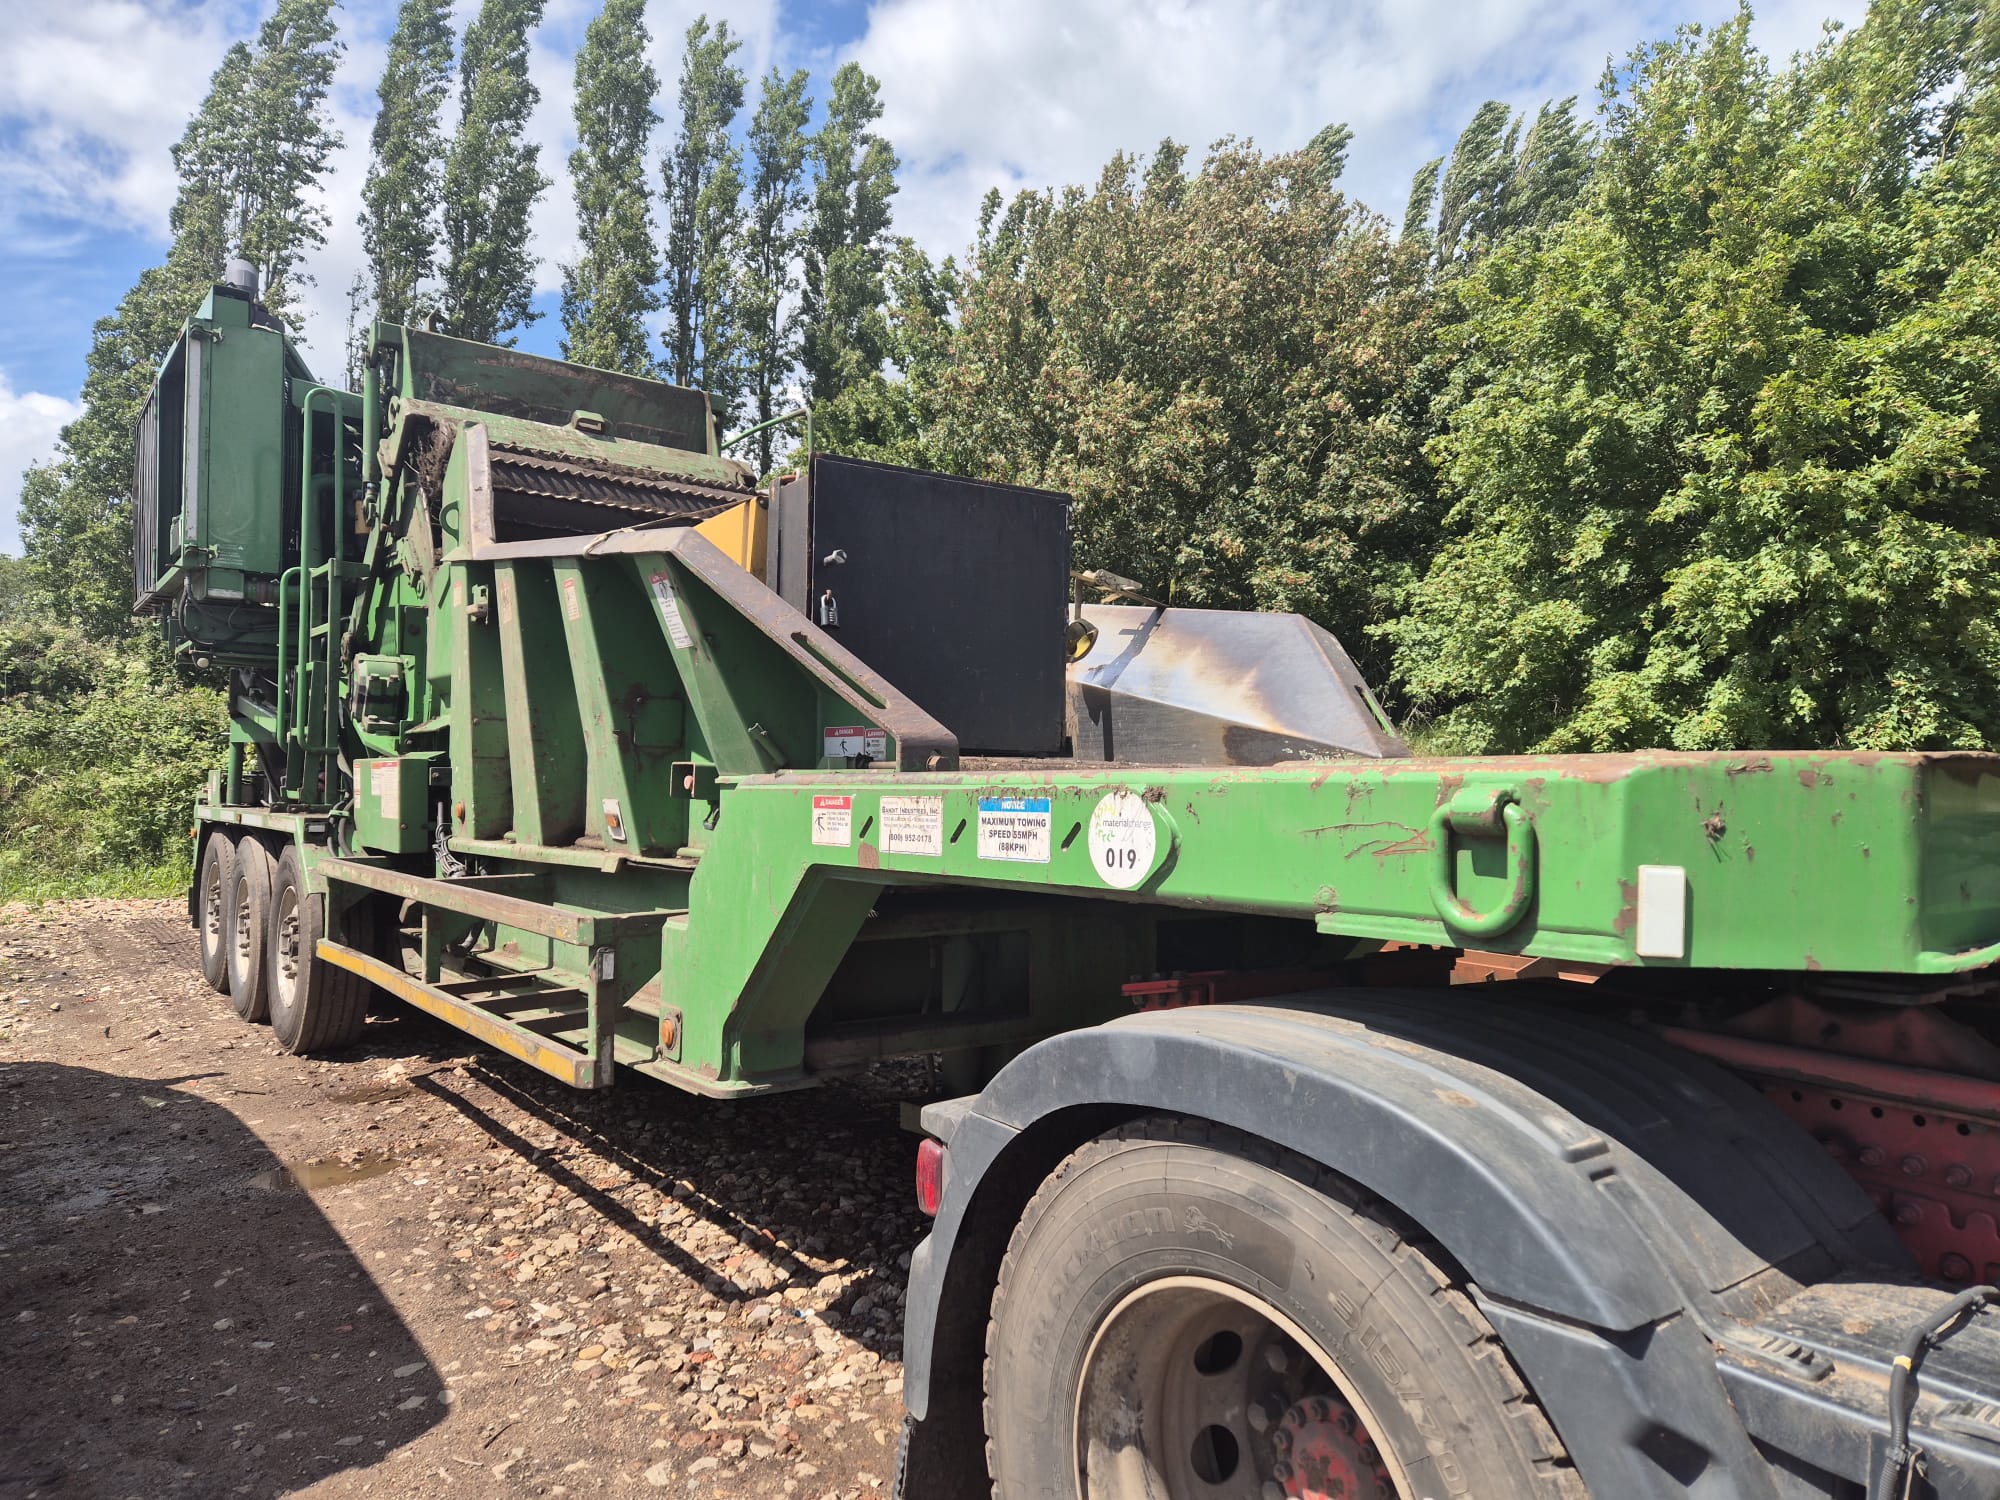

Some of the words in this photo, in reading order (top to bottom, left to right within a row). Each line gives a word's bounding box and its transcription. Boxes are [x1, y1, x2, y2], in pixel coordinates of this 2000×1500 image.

[881, 806, 898, 814] BANDIT
[1001, 800, 1025, 810] NOTICE
[981, 817, 1015, 826] MAXIMUM
[1017, 818, 1047, 828] TOWING
[988, 830, 1011, 839] SPEED
[1012, 831, 1038, 840] 55MPH
[998, 842, 1027, 853] (88KPH)
[1106, 847, 1137, 869] 019
